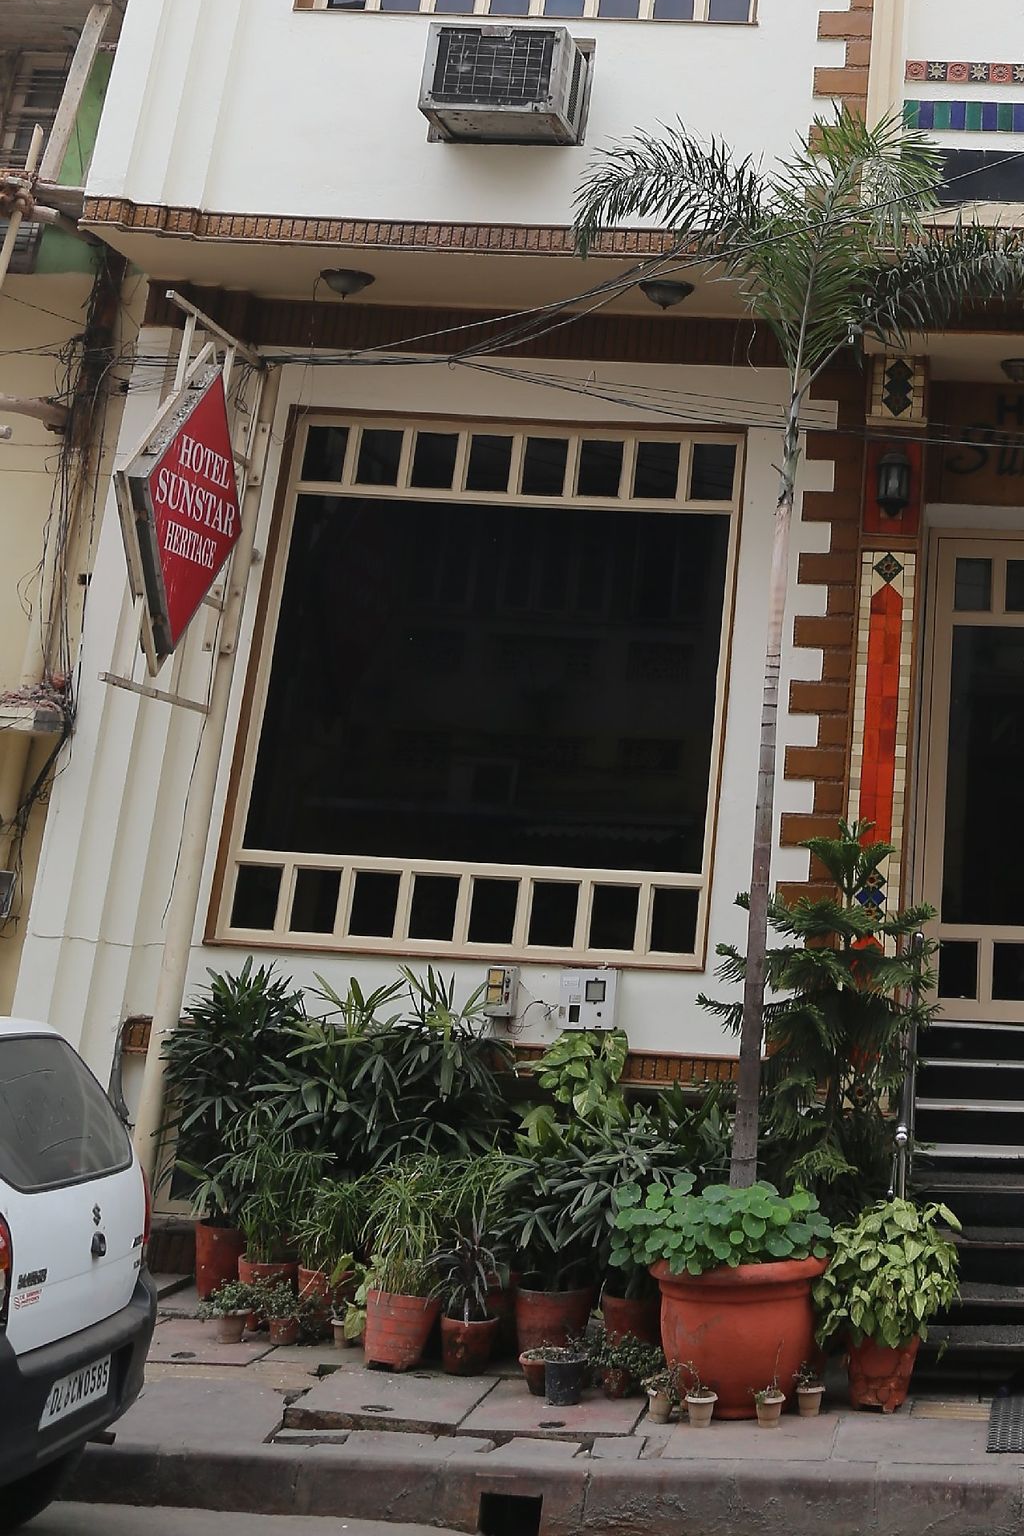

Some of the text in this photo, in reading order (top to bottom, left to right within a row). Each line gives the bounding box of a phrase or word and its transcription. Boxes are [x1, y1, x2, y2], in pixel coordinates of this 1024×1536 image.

[179, 434, 230, 490] HOTEL
[156, 467, 235, 538] SUNSTAR
[164, 520, 217, 569] HERITAGE
